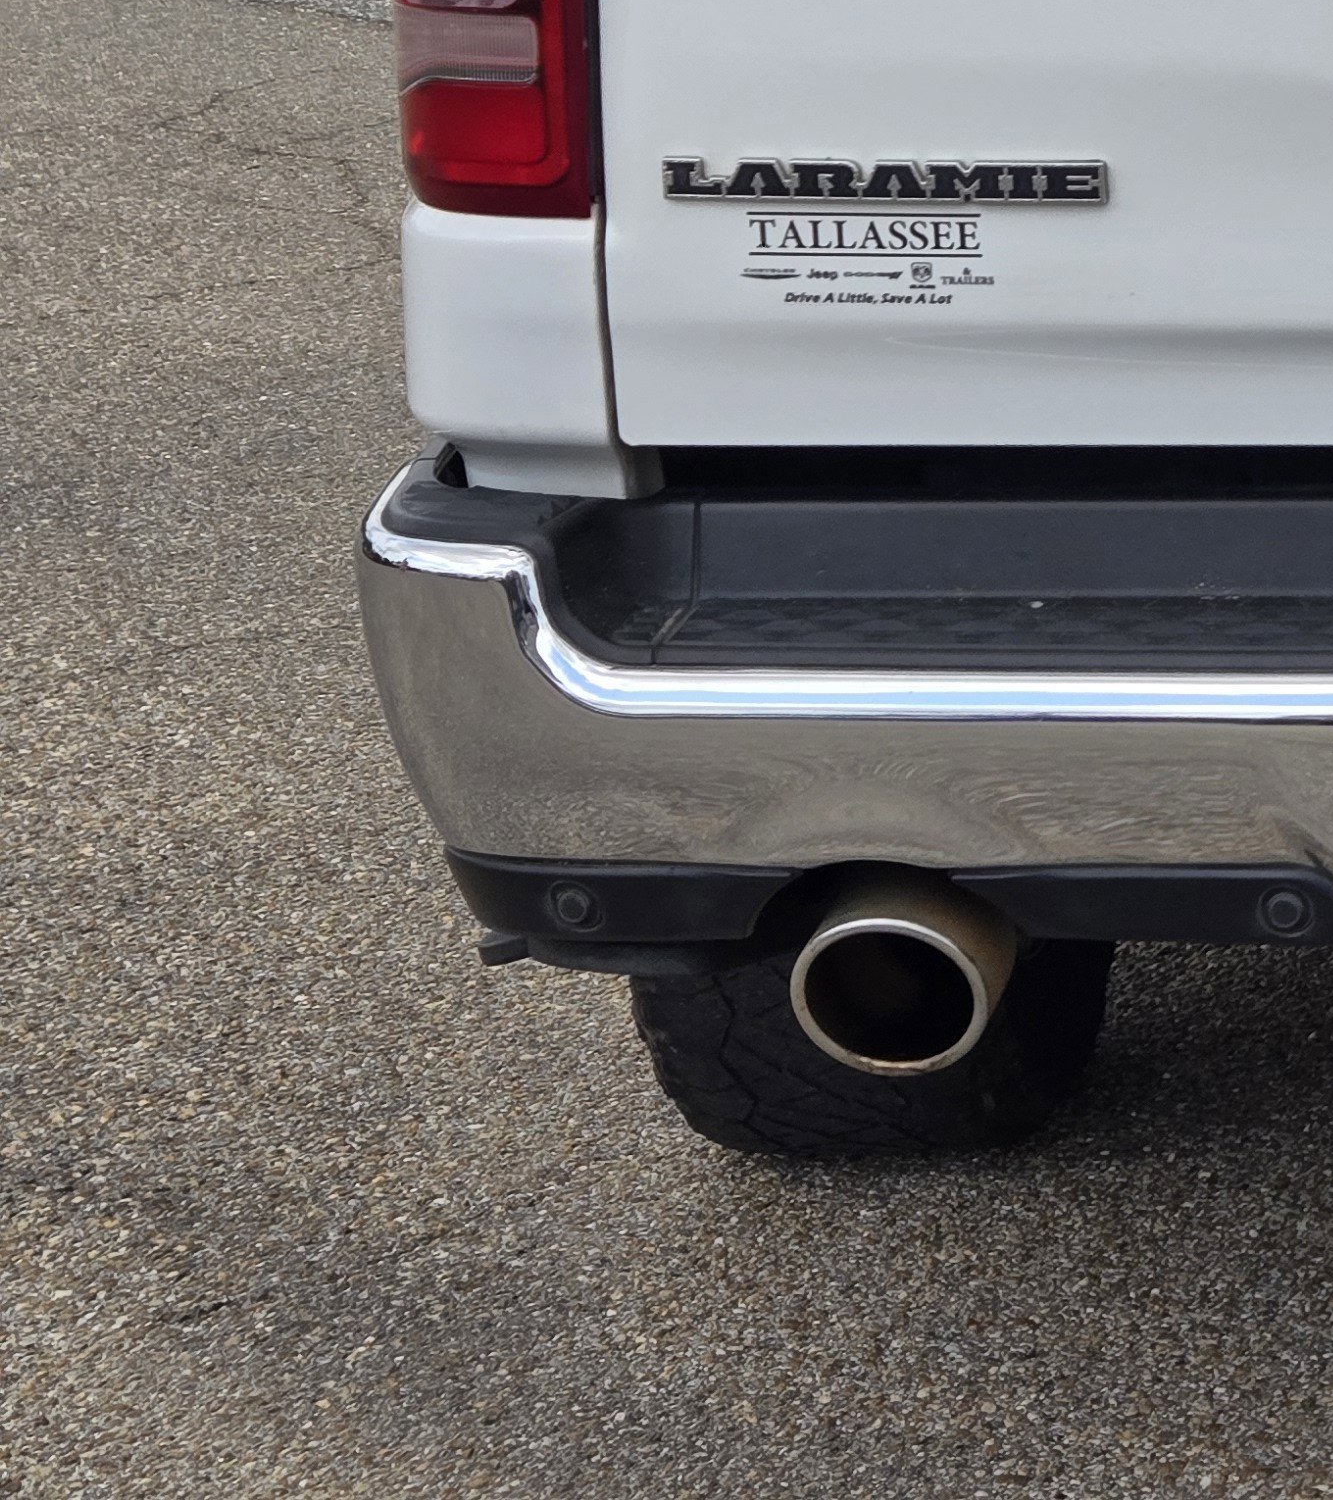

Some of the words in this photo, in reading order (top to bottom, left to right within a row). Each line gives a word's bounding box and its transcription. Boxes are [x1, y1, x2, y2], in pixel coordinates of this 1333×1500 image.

[663, 157, 1108, 204] LARAMIE
[749, 218, 981, 251] TALLASSEE
[806, 268, 838, 281] Jeep
[941, 276, 995, 285] TRAILERS
[784, 292, 821, 303] Drive
[823, 292, 834, 303] A
[837, 292, 878, 304] Little,
[880, 293, 913, 304] Save
[914, 293, 926, 304] A
[928, 293, 953, 304] Lot
